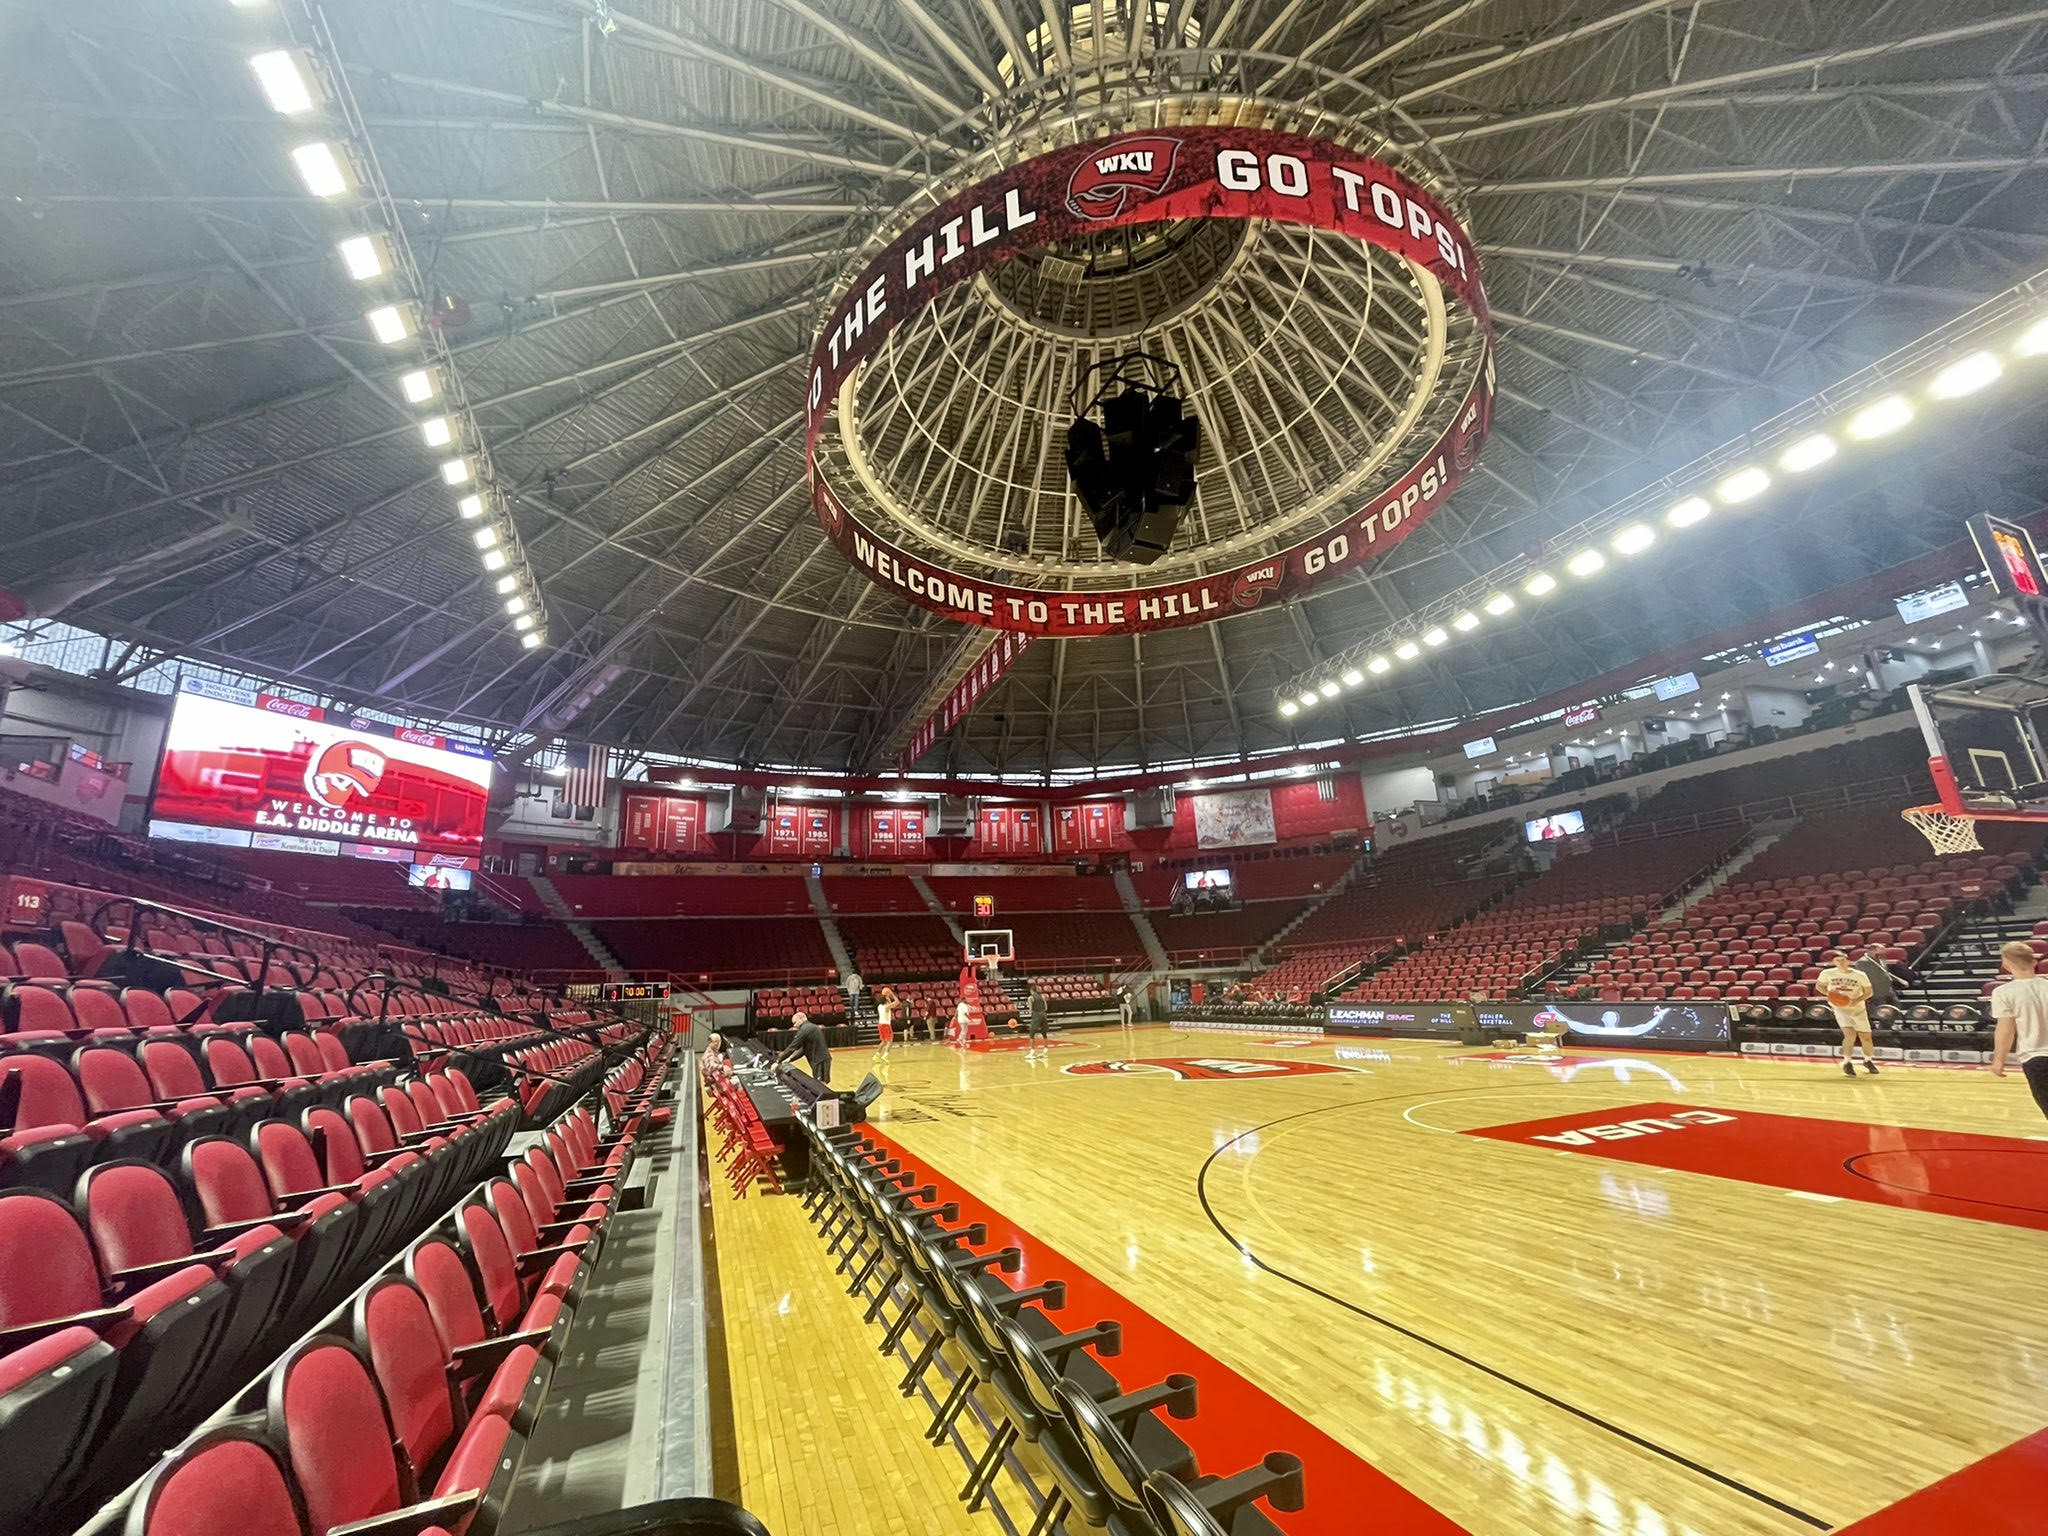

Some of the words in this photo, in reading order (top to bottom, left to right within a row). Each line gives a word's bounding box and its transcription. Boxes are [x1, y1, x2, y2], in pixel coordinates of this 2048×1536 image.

[1095, 151, 1154, 174] WKU
[1216, 149, 1310, 197] GO
[1332, 166, 1468, 282] TOPS!
[828, 273, 887, 370] THE
[905, 188, 1037, 290] HILL
[1303, 534, 1349, 575] GO
[1360, 454, 1448, 544] TOPS!
[853, 531, 994, 616] WELCOME
[1006, 597, 1048, 623] TO
[1061, 602, 1126, 625] THE
[1138, 588, 1219, 621] HILL
[1247, 566, 1274, 583] WKU
[271, 799, 377, 825] WELCOME
[389, 816, 412, 829] TO
[255, 810, 294, 829] E.A.
[298, 815, 360, 837] DIDDLE
[363, 825, 419, 844] ARENA
[774, 829, 795, 837] 1971
[808, 830, 828, 838] 1985
[17, 894, 40, 909] 113
[977, 904, 990, 915] 30
[1329, 1008, 1385, 1020] LEACHMAN
